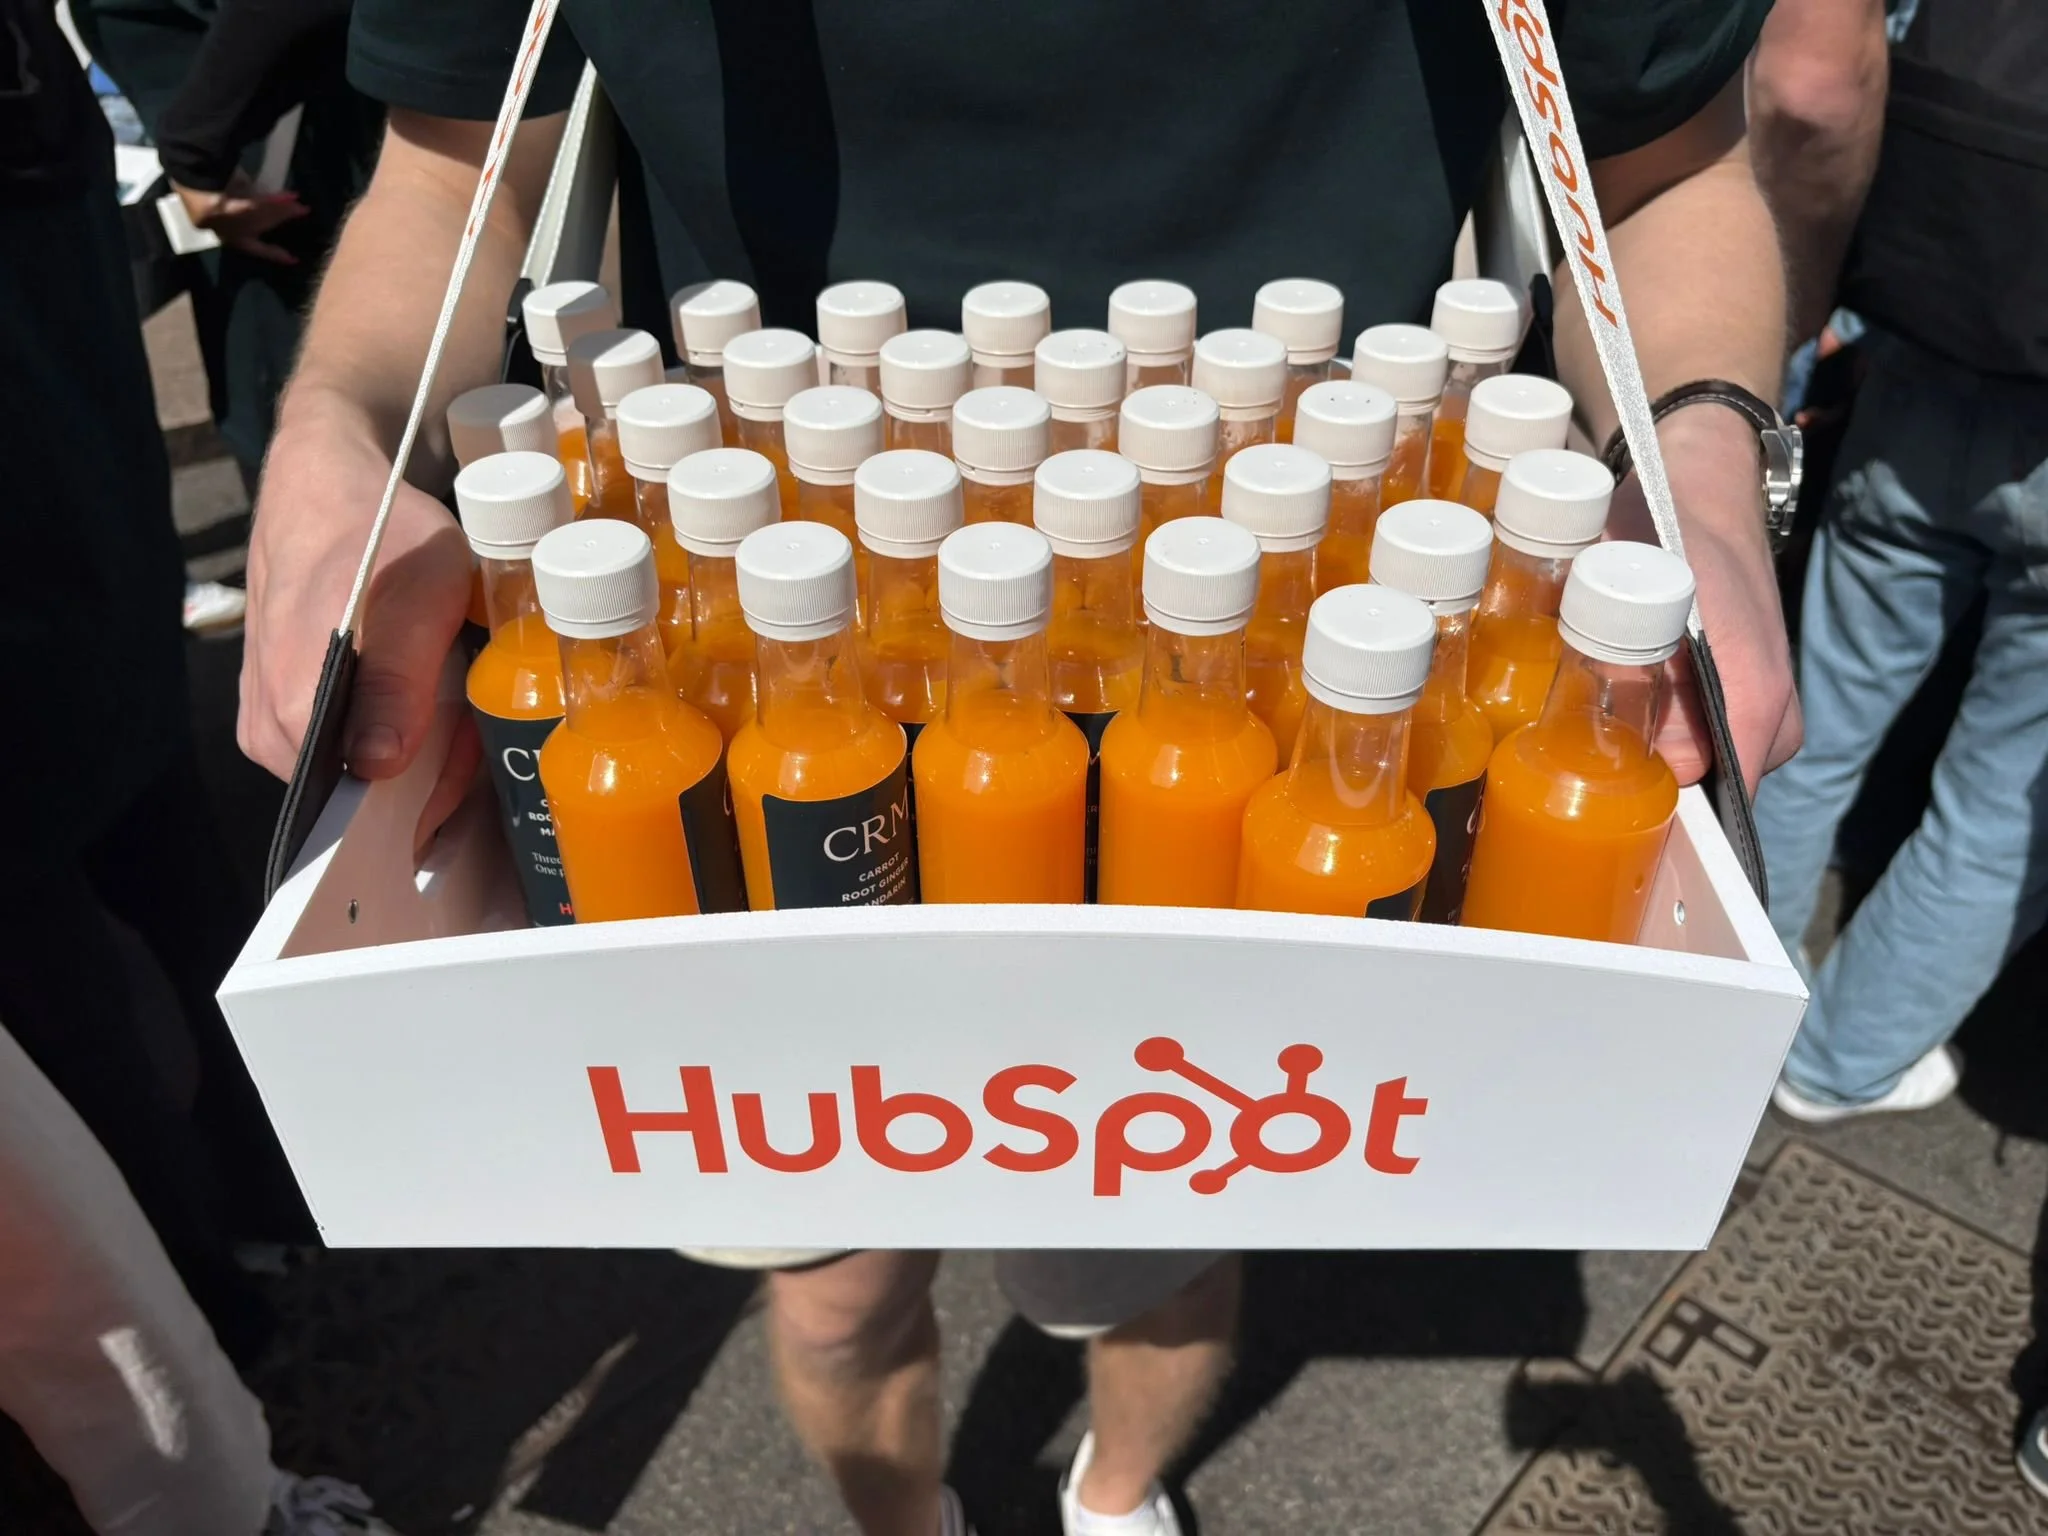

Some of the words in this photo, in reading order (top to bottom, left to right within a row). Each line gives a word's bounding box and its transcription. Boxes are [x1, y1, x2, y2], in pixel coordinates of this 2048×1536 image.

[528, 811, 553, 822] ROO
[823, 783, 910, 862] CRM
[841, 884, 877, 902] ROOT
[878, 856, 910, 888] GINGER
[858, 851, 901, 882] CARROT
[586, 1036, 1430, 1197] HubSpot
